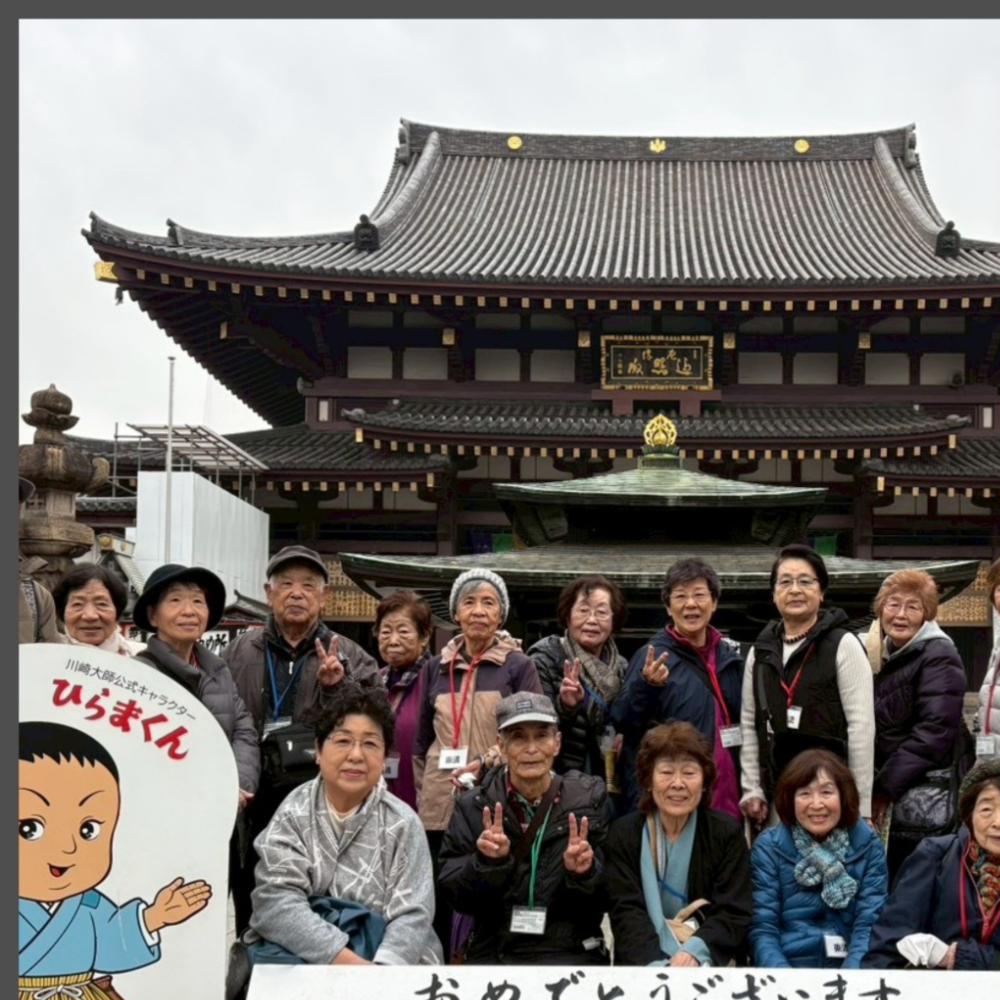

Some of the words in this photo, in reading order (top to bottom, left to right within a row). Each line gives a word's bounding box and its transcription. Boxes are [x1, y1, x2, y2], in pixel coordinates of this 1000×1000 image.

[52, 678, 190, 761] ひらまくん
[65, 658, 196, 720] 川崎大師公式キャラクター
